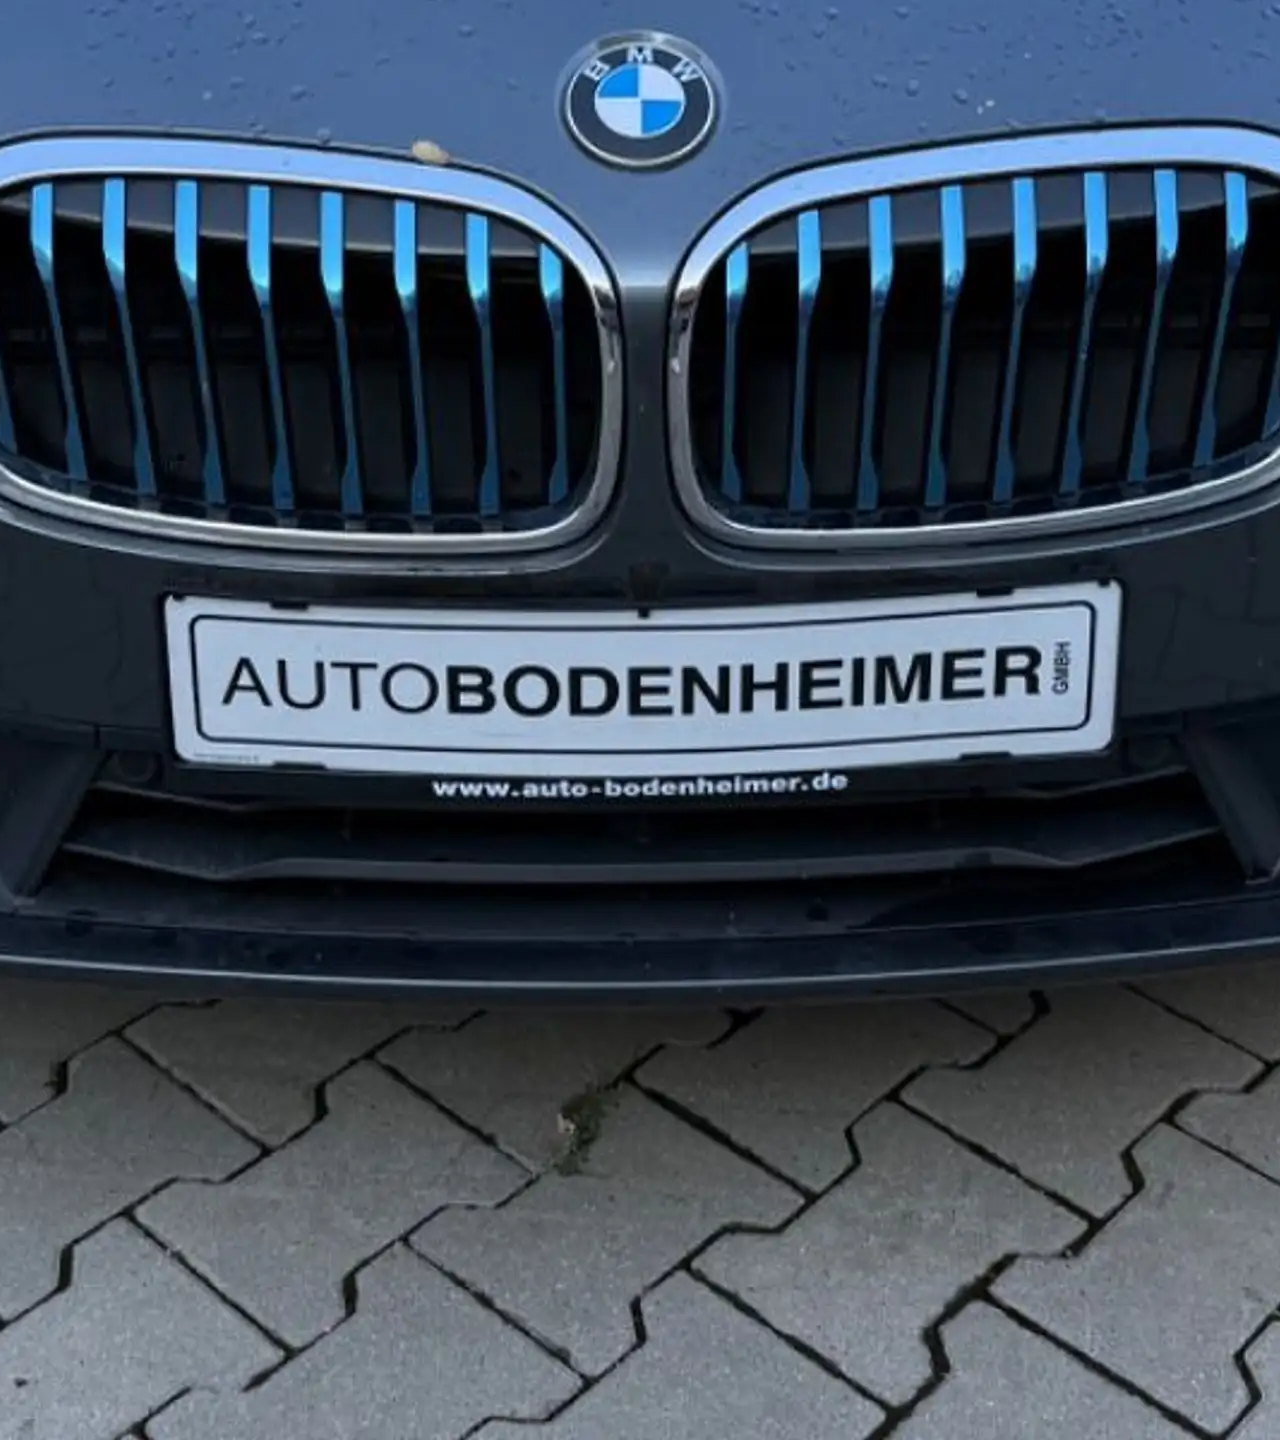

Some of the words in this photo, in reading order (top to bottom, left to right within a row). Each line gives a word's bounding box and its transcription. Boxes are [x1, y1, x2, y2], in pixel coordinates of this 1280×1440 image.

[581, 44, 702, 83] BMW
[222, 644, 1042, 718] AUTOBODENHEIMER
[432, 772, 849, 799] www.auto-bodenheimer.de
